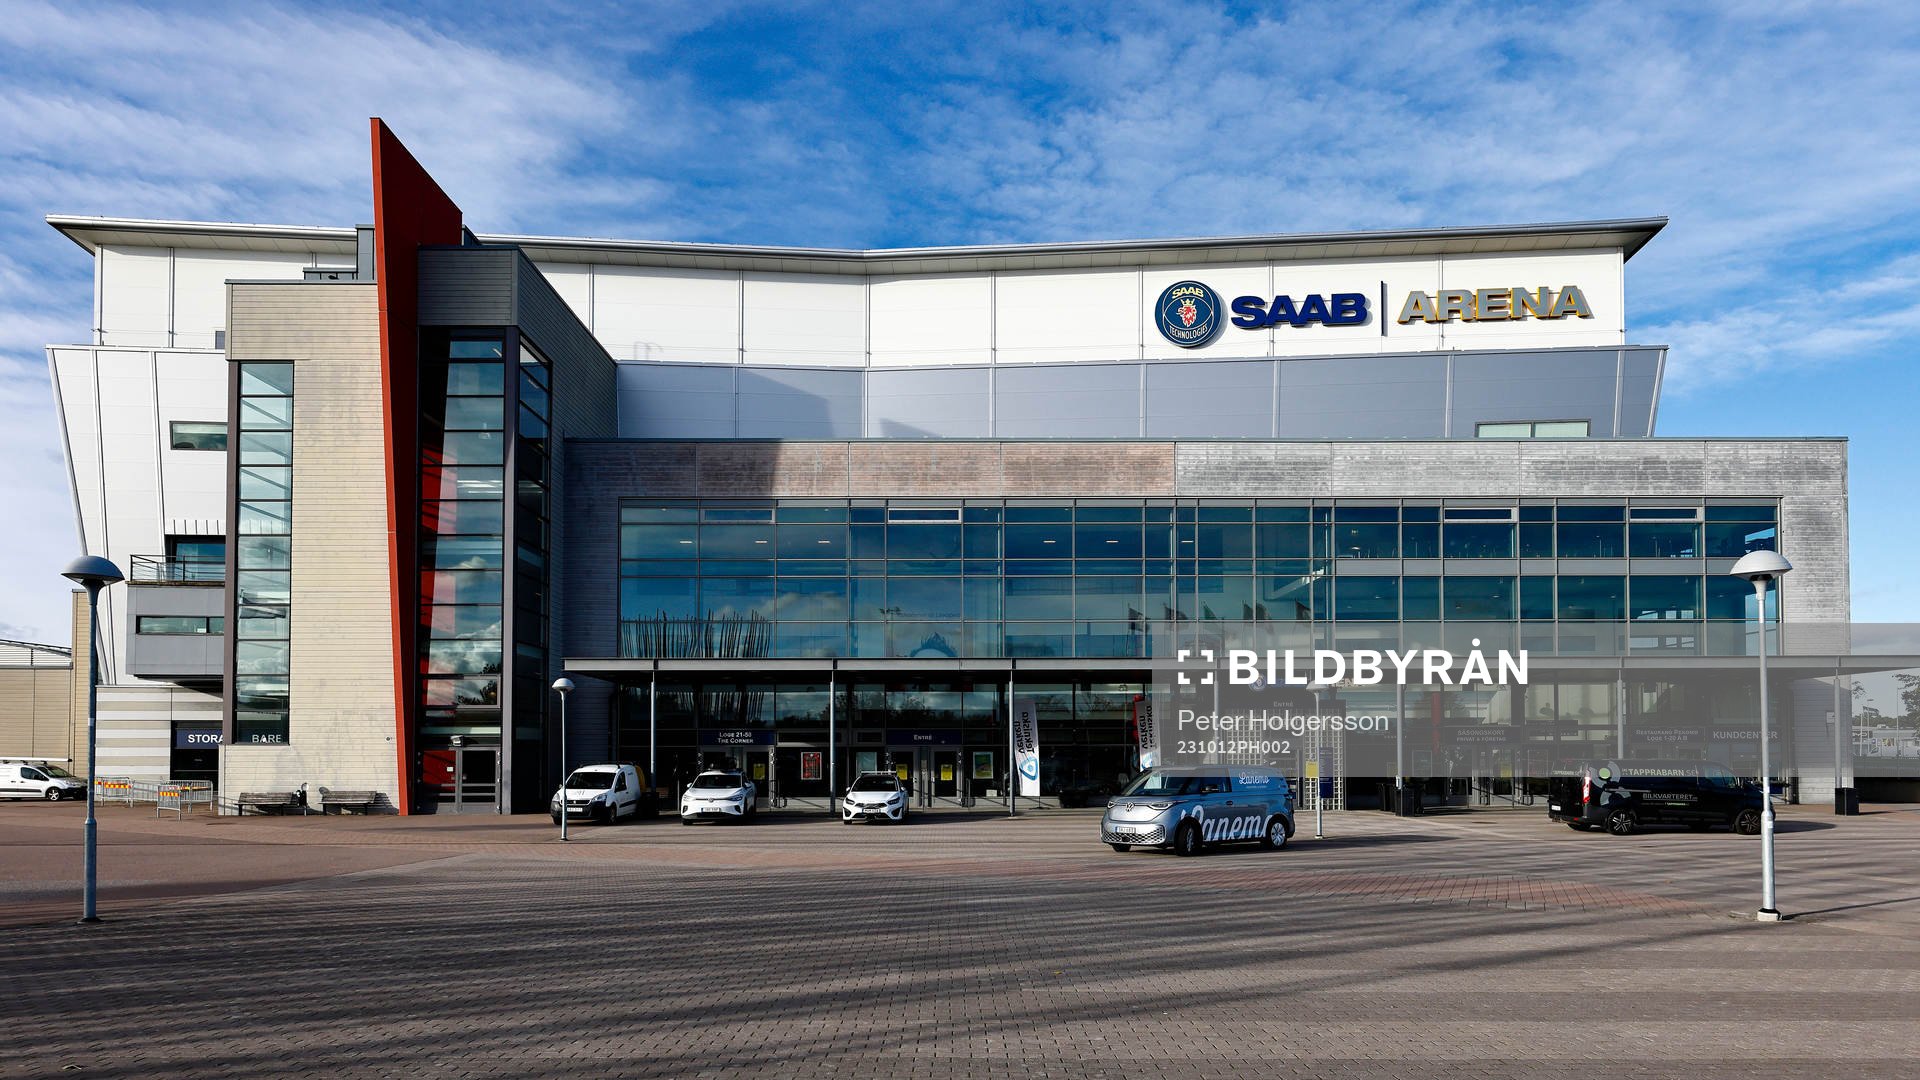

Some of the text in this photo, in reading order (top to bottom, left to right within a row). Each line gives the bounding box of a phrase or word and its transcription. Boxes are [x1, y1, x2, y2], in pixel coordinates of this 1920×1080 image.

[1172, 286, 1204, 299] SAAB
[1230, 285, 1592, 329] SAAB ARENA
[1169, 324, 1208, 340] TECHNOLOGIES
[1713, 730, 1778, 739] KUNDCENER
